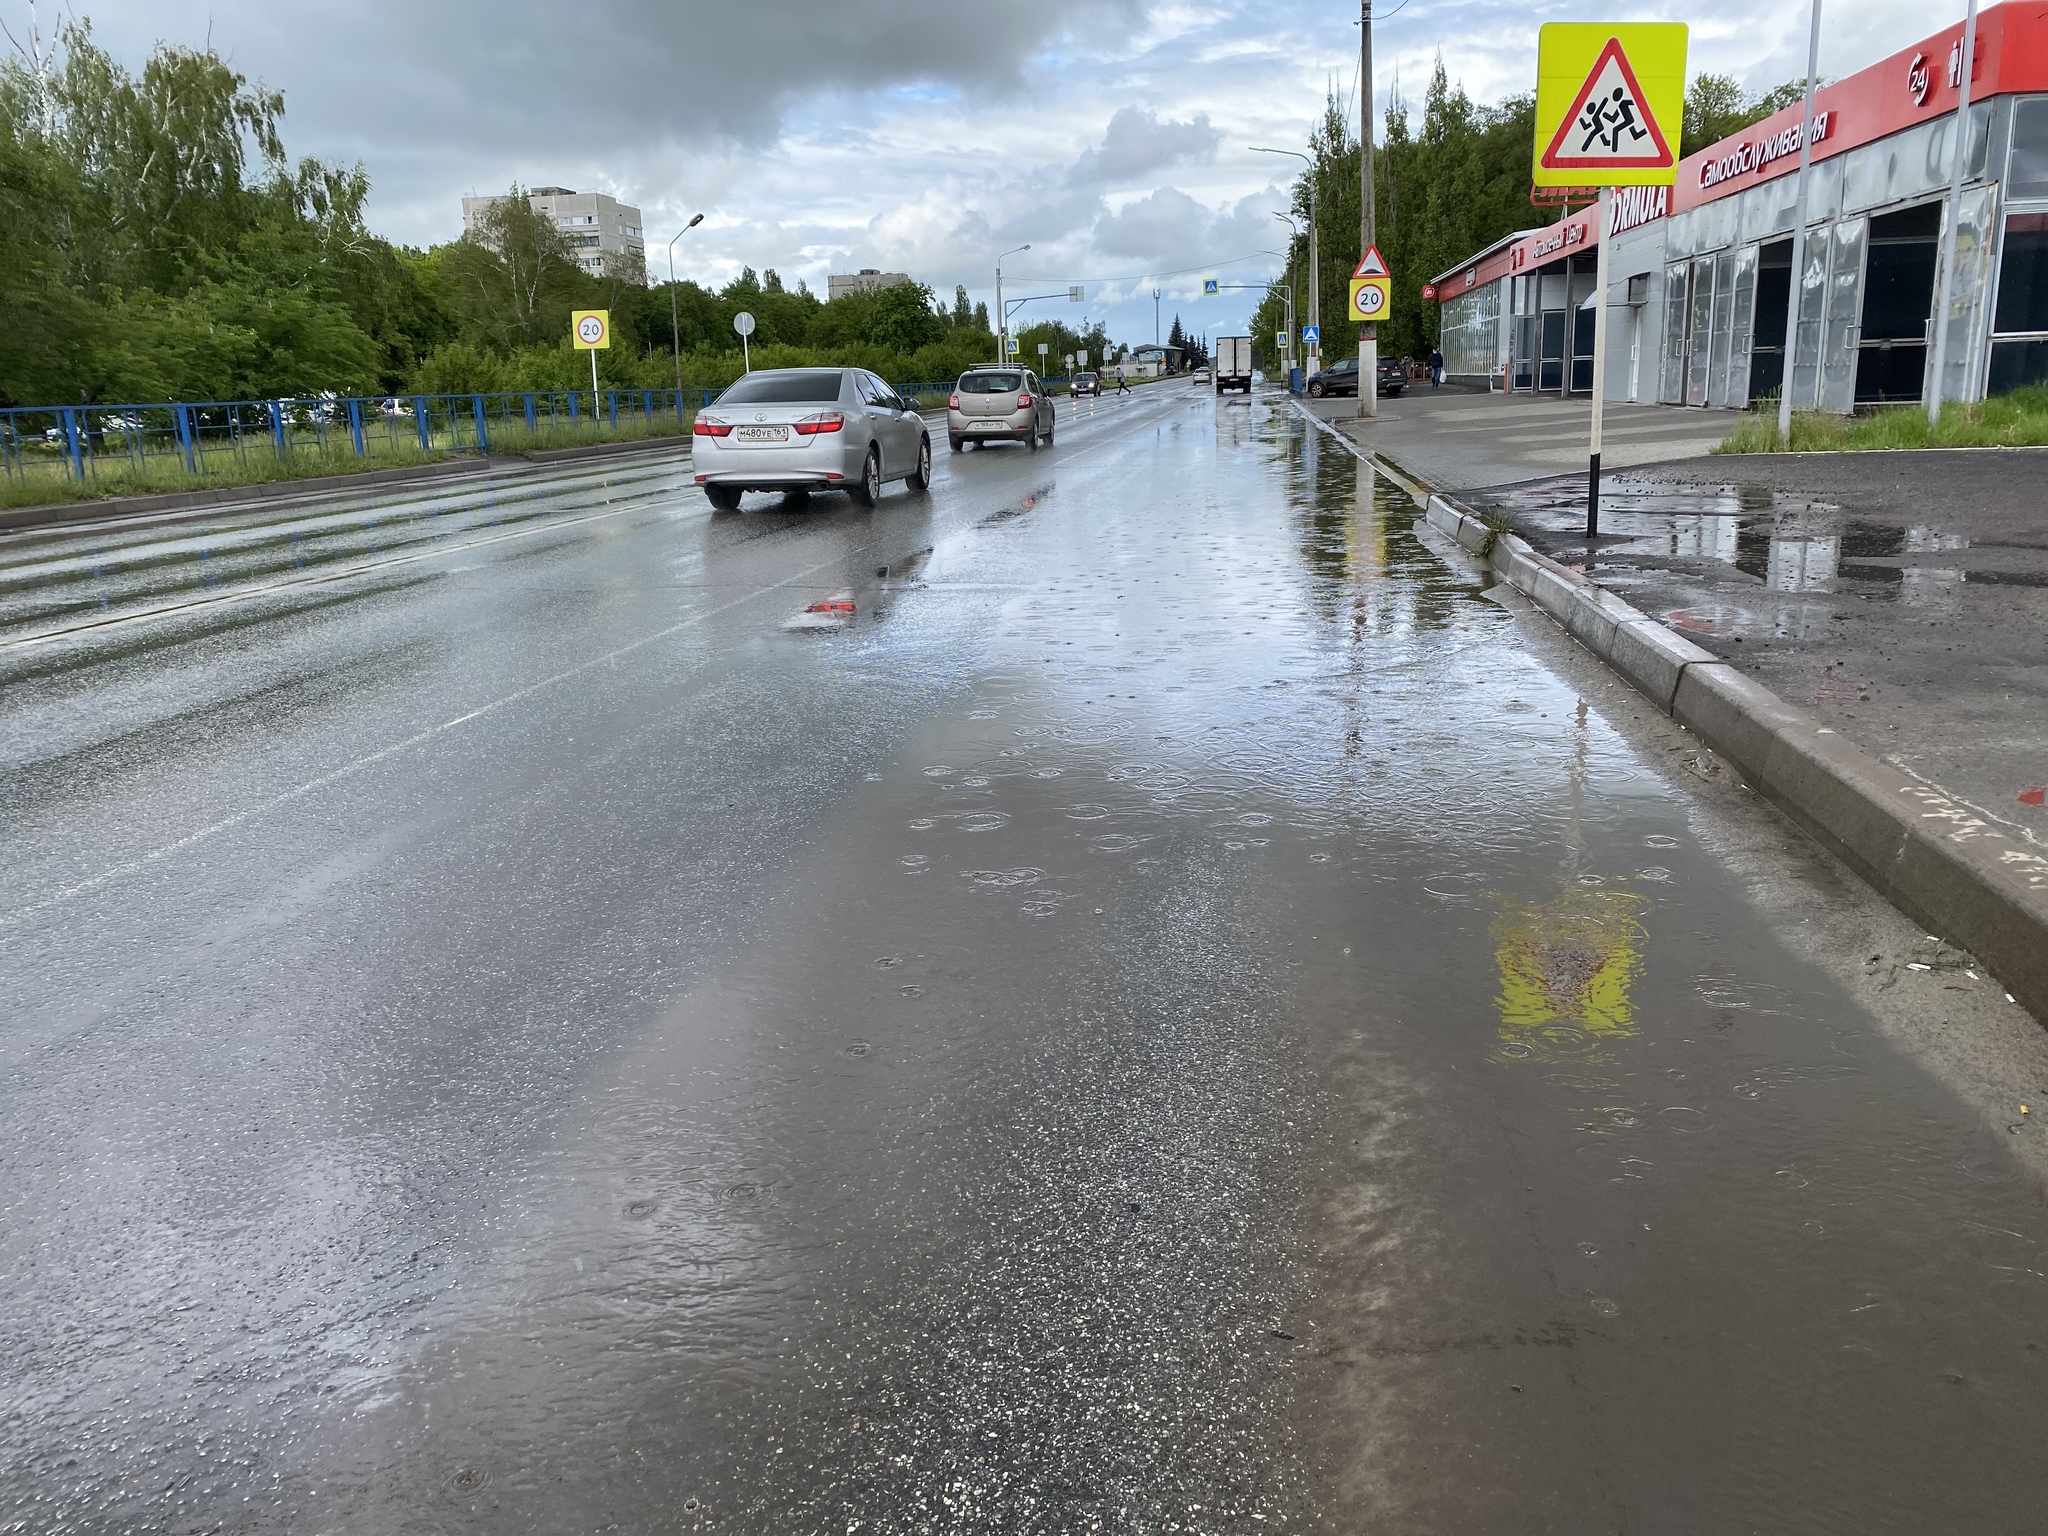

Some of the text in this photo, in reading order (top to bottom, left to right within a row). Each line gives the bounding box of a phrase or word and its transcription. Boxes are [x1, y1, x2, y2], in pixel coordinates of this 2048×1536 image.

[1910, 67, 1926, 92] 24
[1360, 292, 1379, 306] 20
[583, 324, 599, 336] 20
[773, 428, 787, 437] 161
